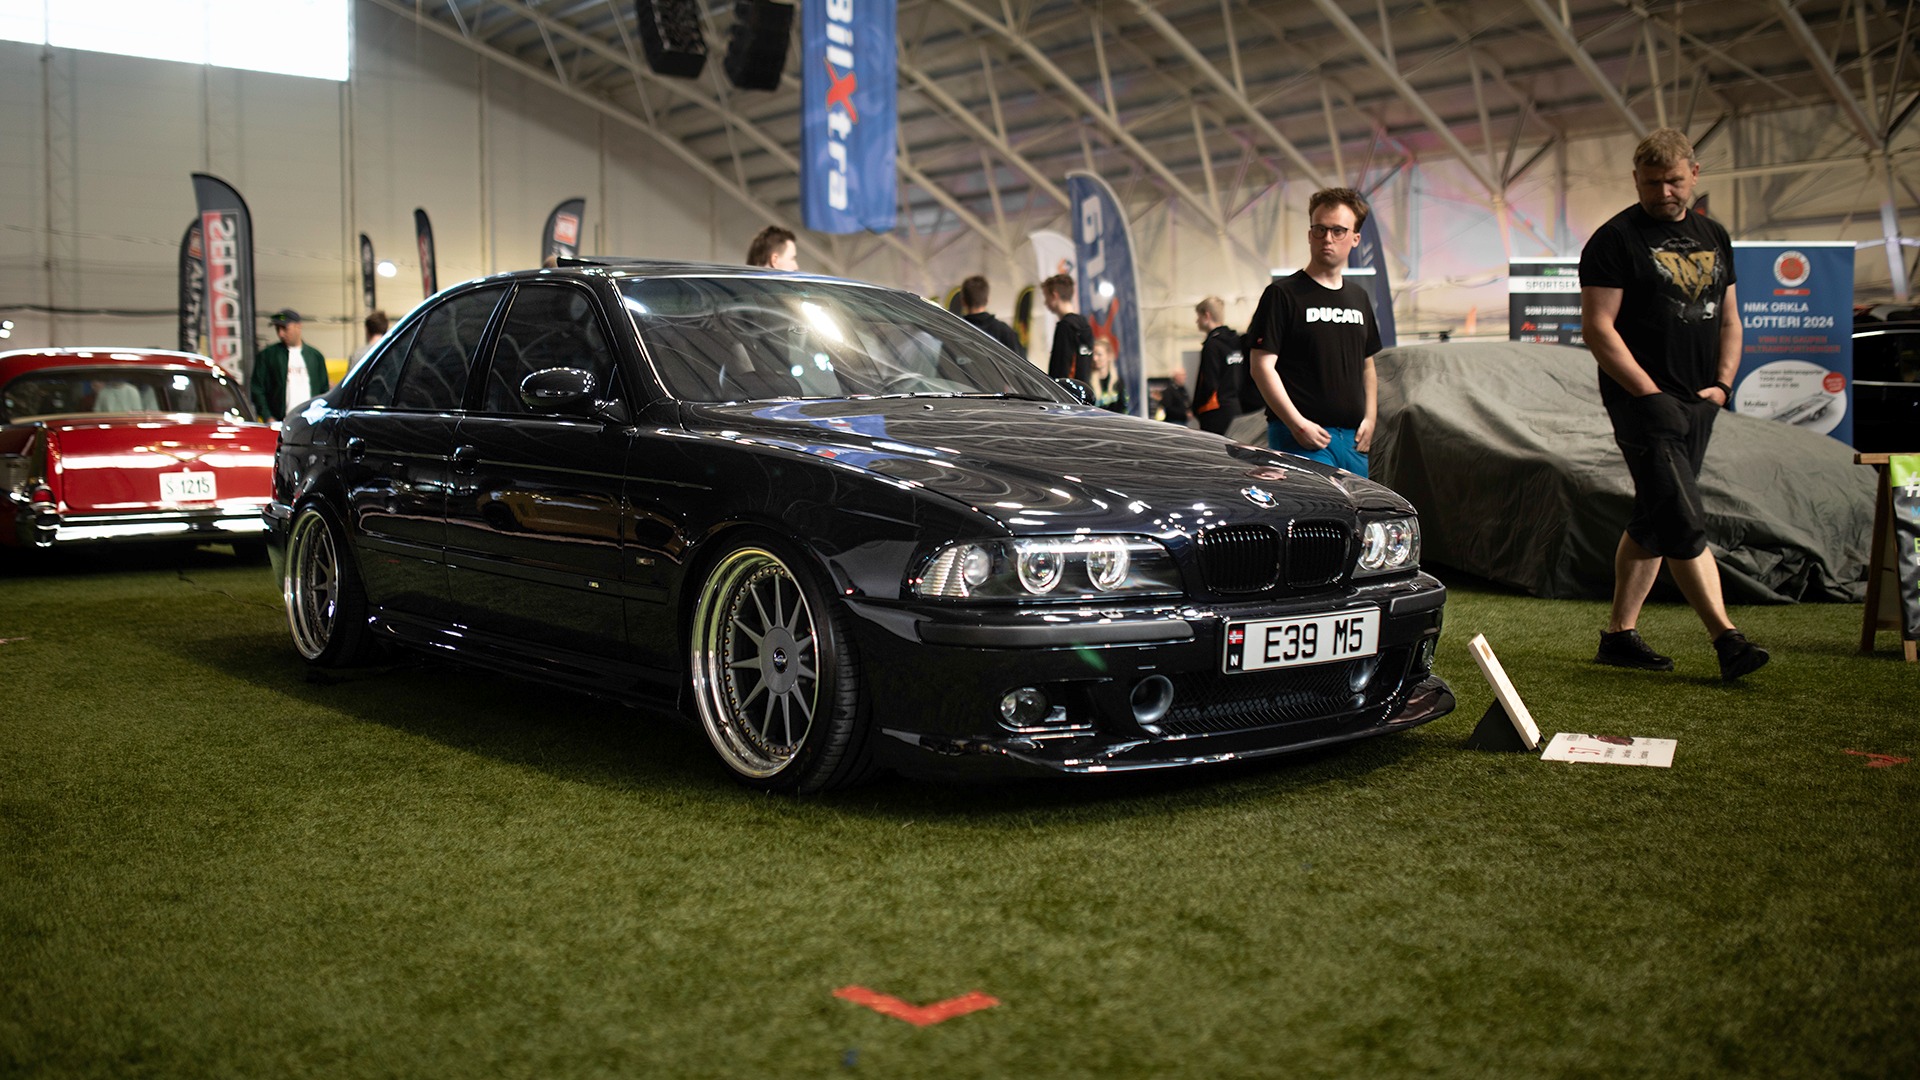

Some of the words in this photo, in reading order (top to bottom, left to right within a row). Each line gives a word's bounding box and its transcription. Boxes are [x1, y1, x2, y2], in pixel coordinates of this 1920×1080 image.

[1744, 302, 1769, 313] NMK
[1771, 302, 1809, 313] ORKLA
[1306, 307, 1364, 325] DUCATI
[1744, 316, 1801, 328] LOTTERI
[1803, 316, 1834, 328] 2024
[181, 476, 210, 494] 1215
[1264, 623, 1318, 663] E39
[1333, 617, 1364, 656] M5
[1230, 654, 1239, 667] N
